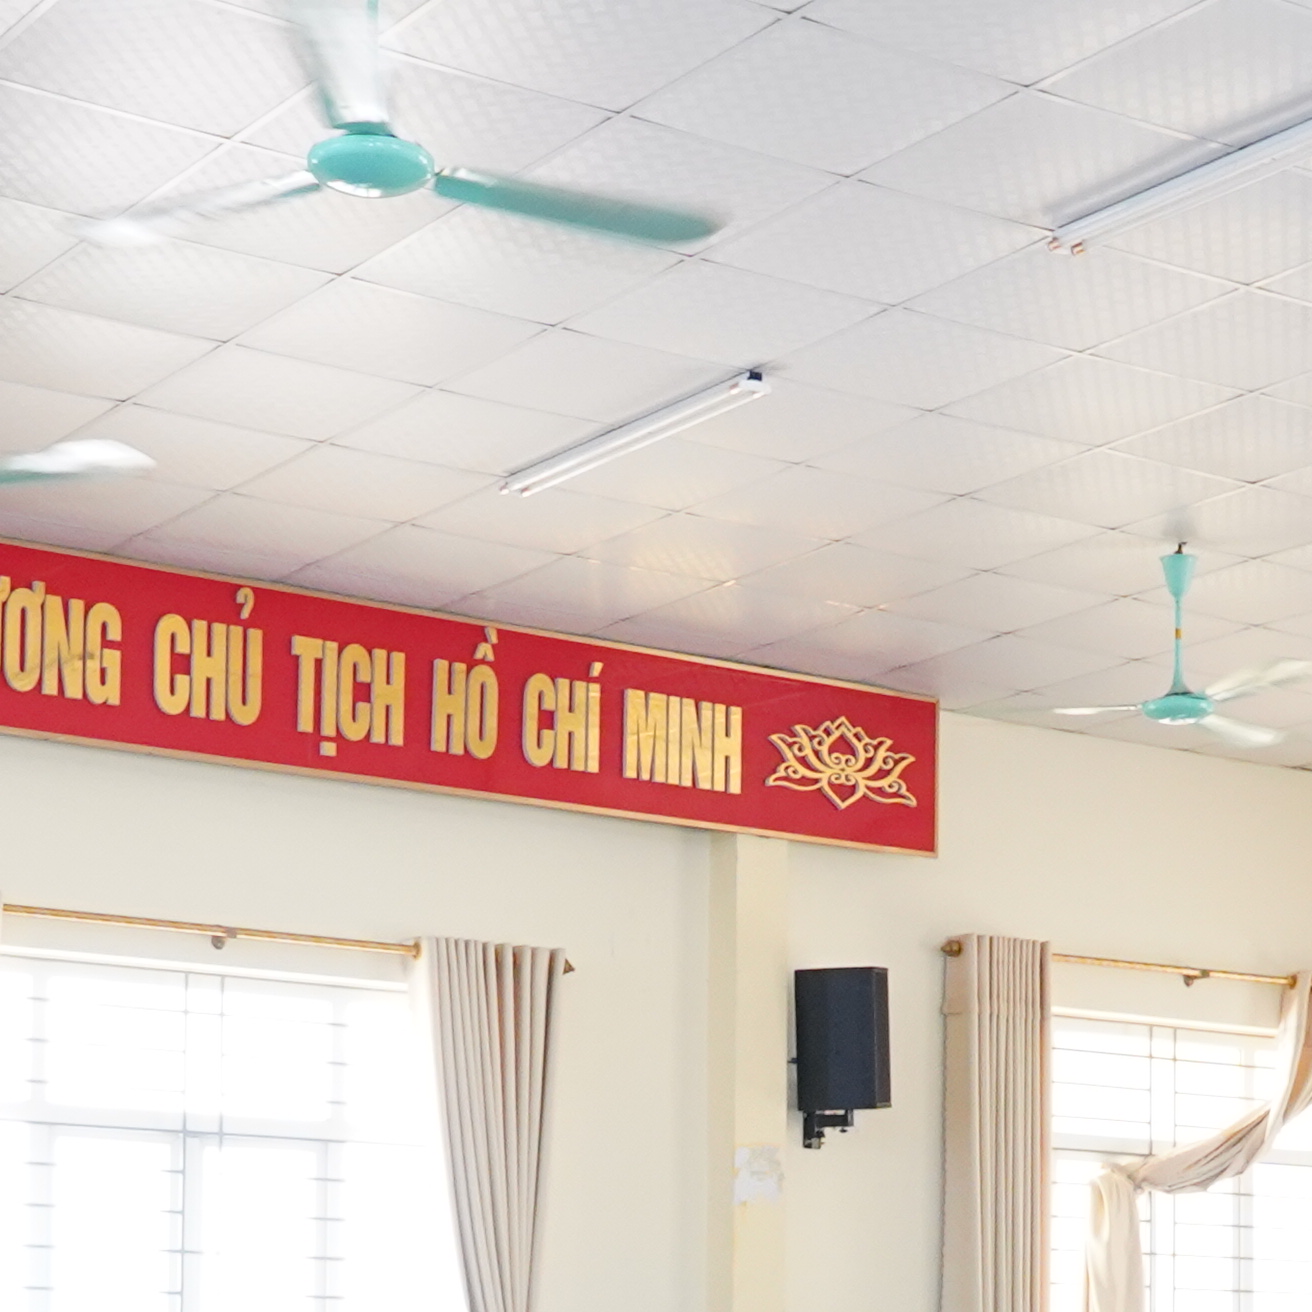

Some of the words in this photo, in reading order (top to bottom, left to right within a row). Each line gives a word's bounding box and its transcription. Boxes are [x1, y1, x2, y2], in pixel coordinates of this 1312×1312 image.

[153, 587, 263, 726] CHỦ
[291, 634, 406, 757] TỊCH
[431, 627, 500, 760] HỒ
[522, 661, 604, 774] CHÍ
[622, 687, 743, 795] MINH
